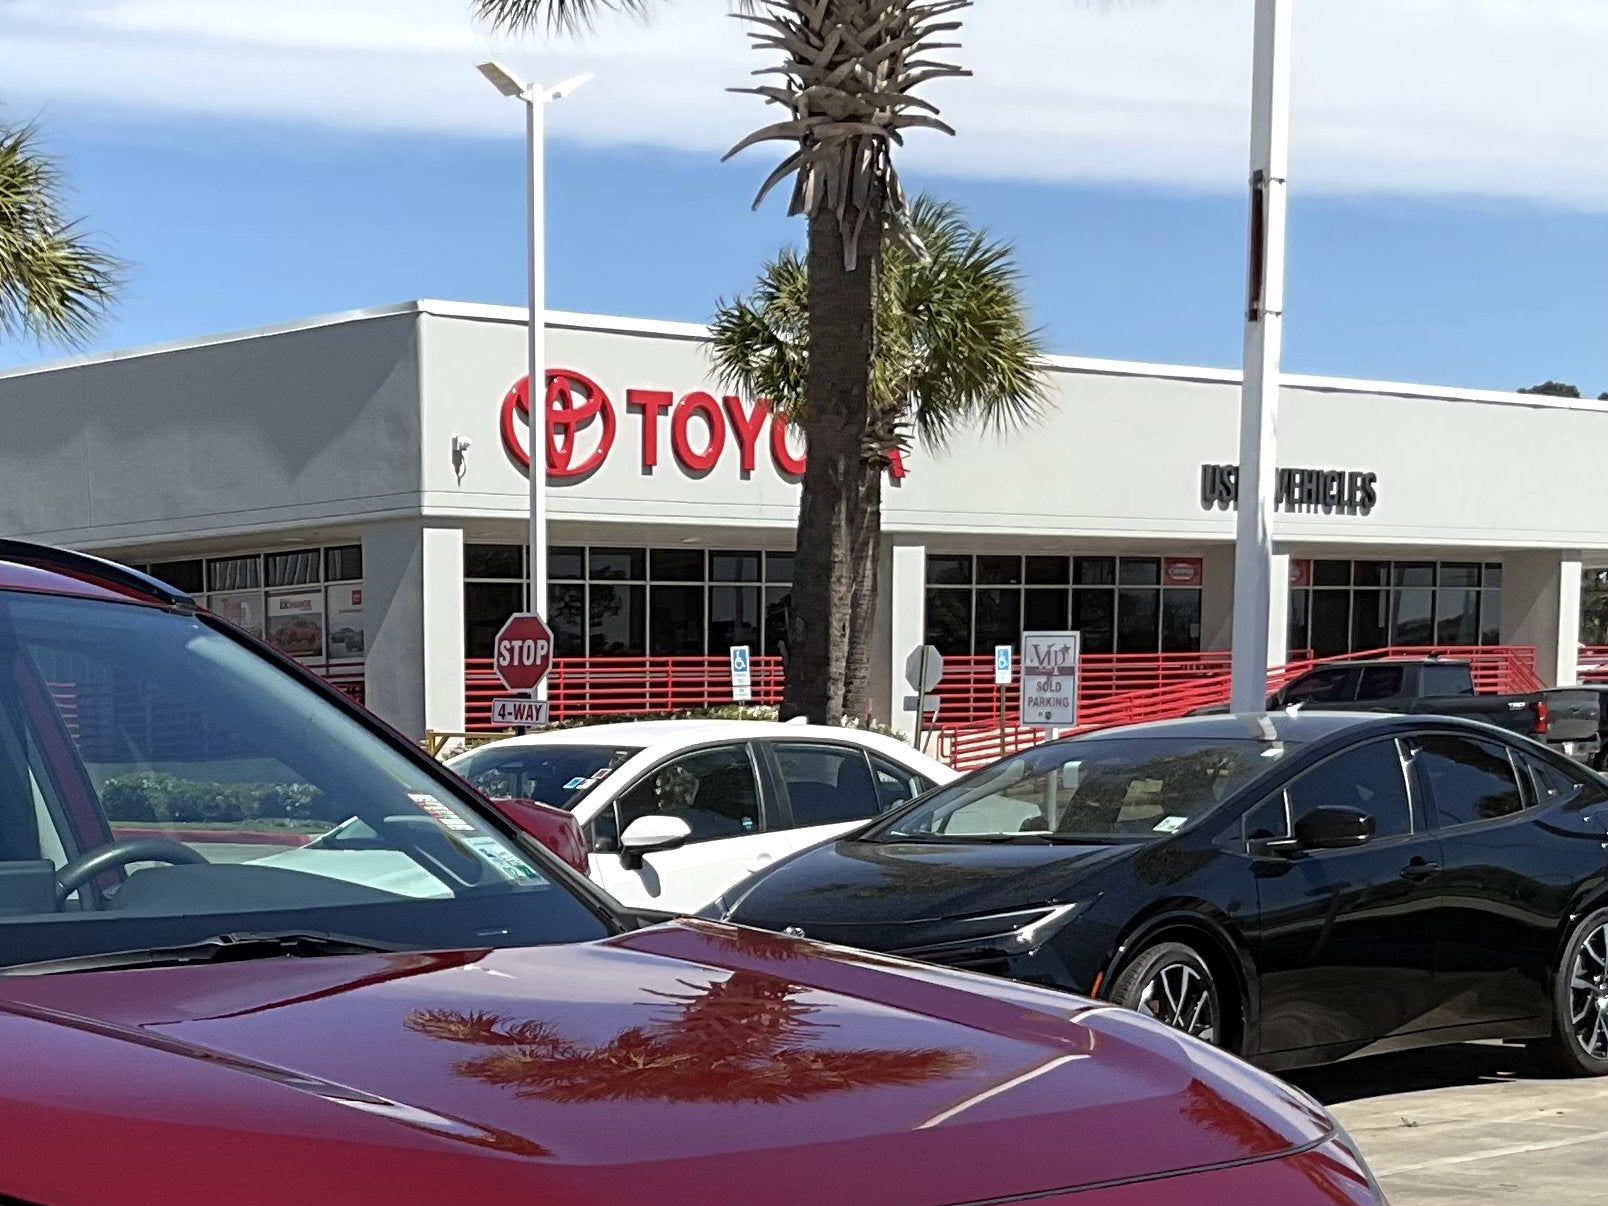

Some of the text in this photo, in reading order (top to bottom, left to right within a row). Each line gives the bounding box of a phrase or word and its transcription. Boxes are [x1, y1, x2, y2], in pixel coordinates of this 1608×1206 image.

[627, 389, 905, 478] TOYO
[499, 639, 549, 667] STOP
[1036, 681, 1062, 693] SOLD
[1027, 696, 1070, 708] PARKING
[497, 703, 543, 722] 4-WAY
